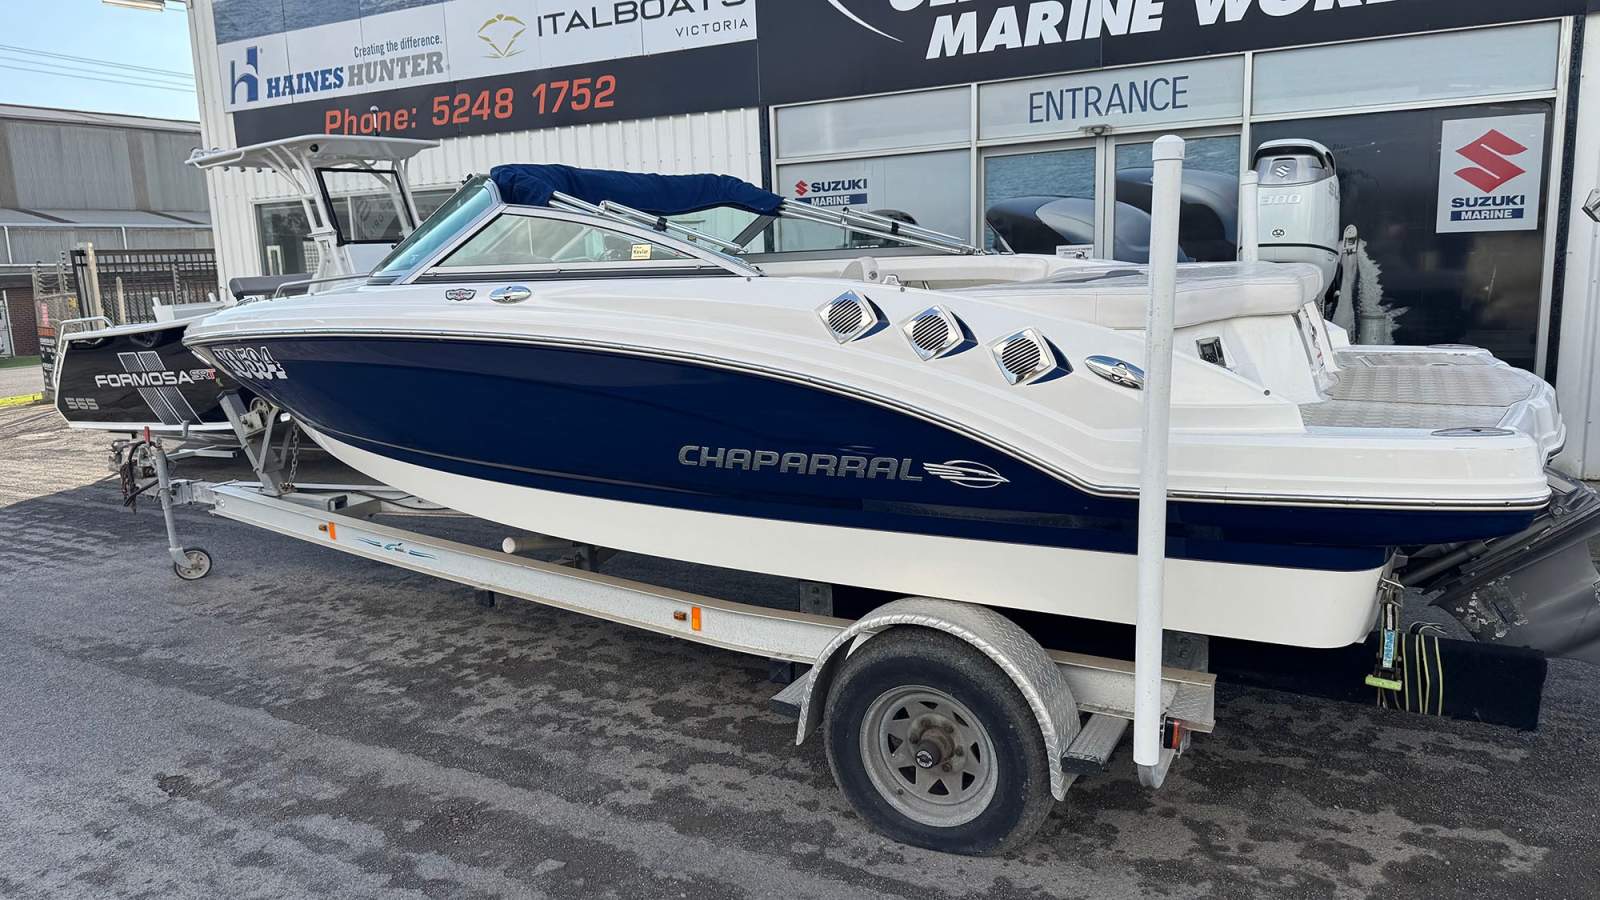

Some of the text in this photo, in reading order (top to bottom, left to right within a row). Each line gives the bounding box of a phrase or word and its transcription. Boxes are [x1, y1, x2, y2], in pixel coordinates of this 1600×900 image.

[537, 0, 746, 37] ITALBOA
[675, 18, 749, 37] VICTORIA
[926, 0, 1164, 60] MARINE
[354, 35, 443, 58] Creating the difference.
[266, 51, 444, 98] HAINES HUNTER
[323, 75, 617, 135] Phone: 5248 1752
[1029, 76, 1190, 123] ENTRANCE
[811, 179, 868, 193] SUZUKI
[810, 195, 850, 207] MARINE
[1451, 194, 1525, 208] SUZUKI
[1461, 209, 1513, 221] MARINE
[95, 371, 194, 389] FORMOSA
[64, 397, 100, 410] 565
[678, 445, 924, 482] CHAPARRAL
